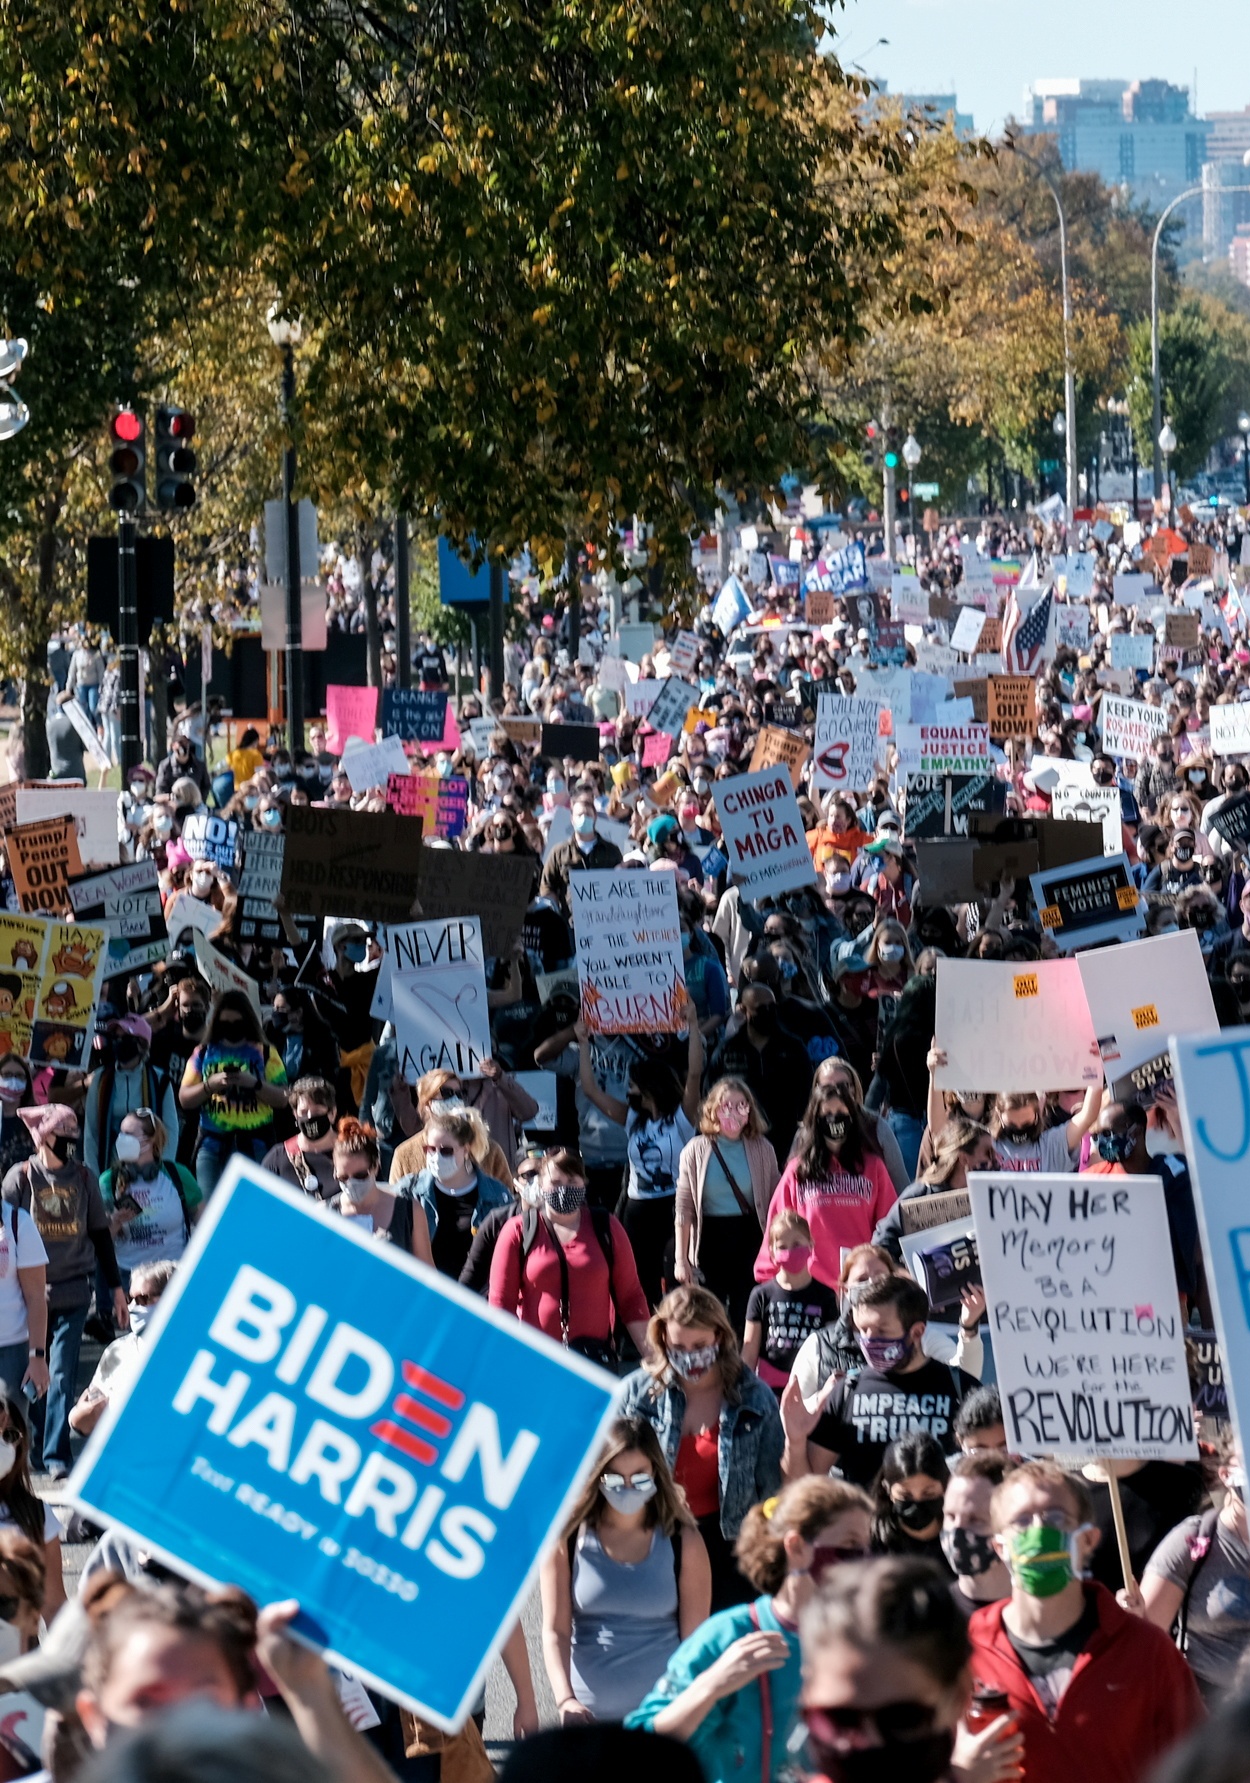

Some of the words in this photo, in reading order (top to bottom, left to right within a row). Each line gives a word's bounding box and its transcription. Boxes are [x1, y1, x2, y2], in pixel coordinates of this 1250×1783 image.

[391, 690, 438, 704] ORANGE
[992, 681, 1030, 692] Trump/
[829, 698, 857, 717] WILL
[857, 700, 879, 715] NOT
[996, 703, 1027, 718] OUT
[1106, 700, 1134, 719] KEEP
[1137, 707, 1165, 727] YOUR
[387, 720, 441, 738] NIXON
[817, 719, 838, 743] GO
[920, 726, 989, 740] EQUALITY
[991, 719, 1034, 734] NOW!
[1106, 717, 1149, 737] ROSARIES
[920, 741, 987, 755] JUSTICE
[1106, 733, 1120, 749] MY
[920, 757, 989, 771] EMPATHY
[907, 773, 944, 792] VOTE
[723, 777, 789, 815] CHINGA
[1054, 791, 1070, 800] NO
[1080, 790, 1119, 800] COUNTRY
[290, 810, 338, 837] BOYS
[748, 806, 775, 829] TU
[13, 827, 68, 850] Trump/
[184, 814, 238, 847] NO!
[733, 822, 799, 862] MAGA
[19, 845, 69, 866] Pence
[26, 860, 70, 888] OUT
[73, 883, 109, 909] REAL
[110, 867, 156, 891] WOMEN
[573, 881, 601, 902] WE
[607, 879, 639, 899] ARE
[641, 878, 672, 897] THE
[1053, 873, 1120, 903] FEMINIST
[110, 896, 150, 916] VOTE
[1040, 907, 1059, 920] OUT
[1068, 891, 1112, 914] VOTER
[1042, 915, 1063, 929] NOW
[394, 920, 480, 971] NEVER
[579, 934, 593, 950] OF
[603, 933, 629, 948] THE
[632, 929, 680, 945] WITCHES
[582, 956, 611, 974] YOU
[613, 950, 673, 968] WEREN'T
[594, 974, 630, 990] ABLE
[645, 971, 668, 987] TO
[1015, 986, 1038, 998] NOW
[1016, 979, 1037, 989] OUT
[599, 991, 672, 1023] BURN
[1135, 1010, 1155, 1021] OUT
[1136, 1016, 1159, 1029] NOW
[401, 1038, 487, 1077] AGAIN
[1136, 1072, 1160, 1091] ON
[988, 1185, 1053, 1226] MAY
[1069, 1187, 1132, 1221] HER
[1001, 1228, 1116, 1277] Memory
[1081, 1277, 1097, 1297] A
[994, 1301, 1176, 1343] REVOLUTION
[1023, 1352, 1102, 1380] WE'RE
[1112, 1354, 1177, 1375] HERE
[207, 1263, 540, 1511] BIDEN
[852, 1392, 951, 1418] IMPEACH
[1007, 1386, 1195, 1445] REVOLUTION
[851, 1416, 949, 1445] TRUMP
[171, 1348, 497, 1580] HARRIS
[235, 1479, 318, 1541] READY
[341, 1547, 420, 1602] 30330
